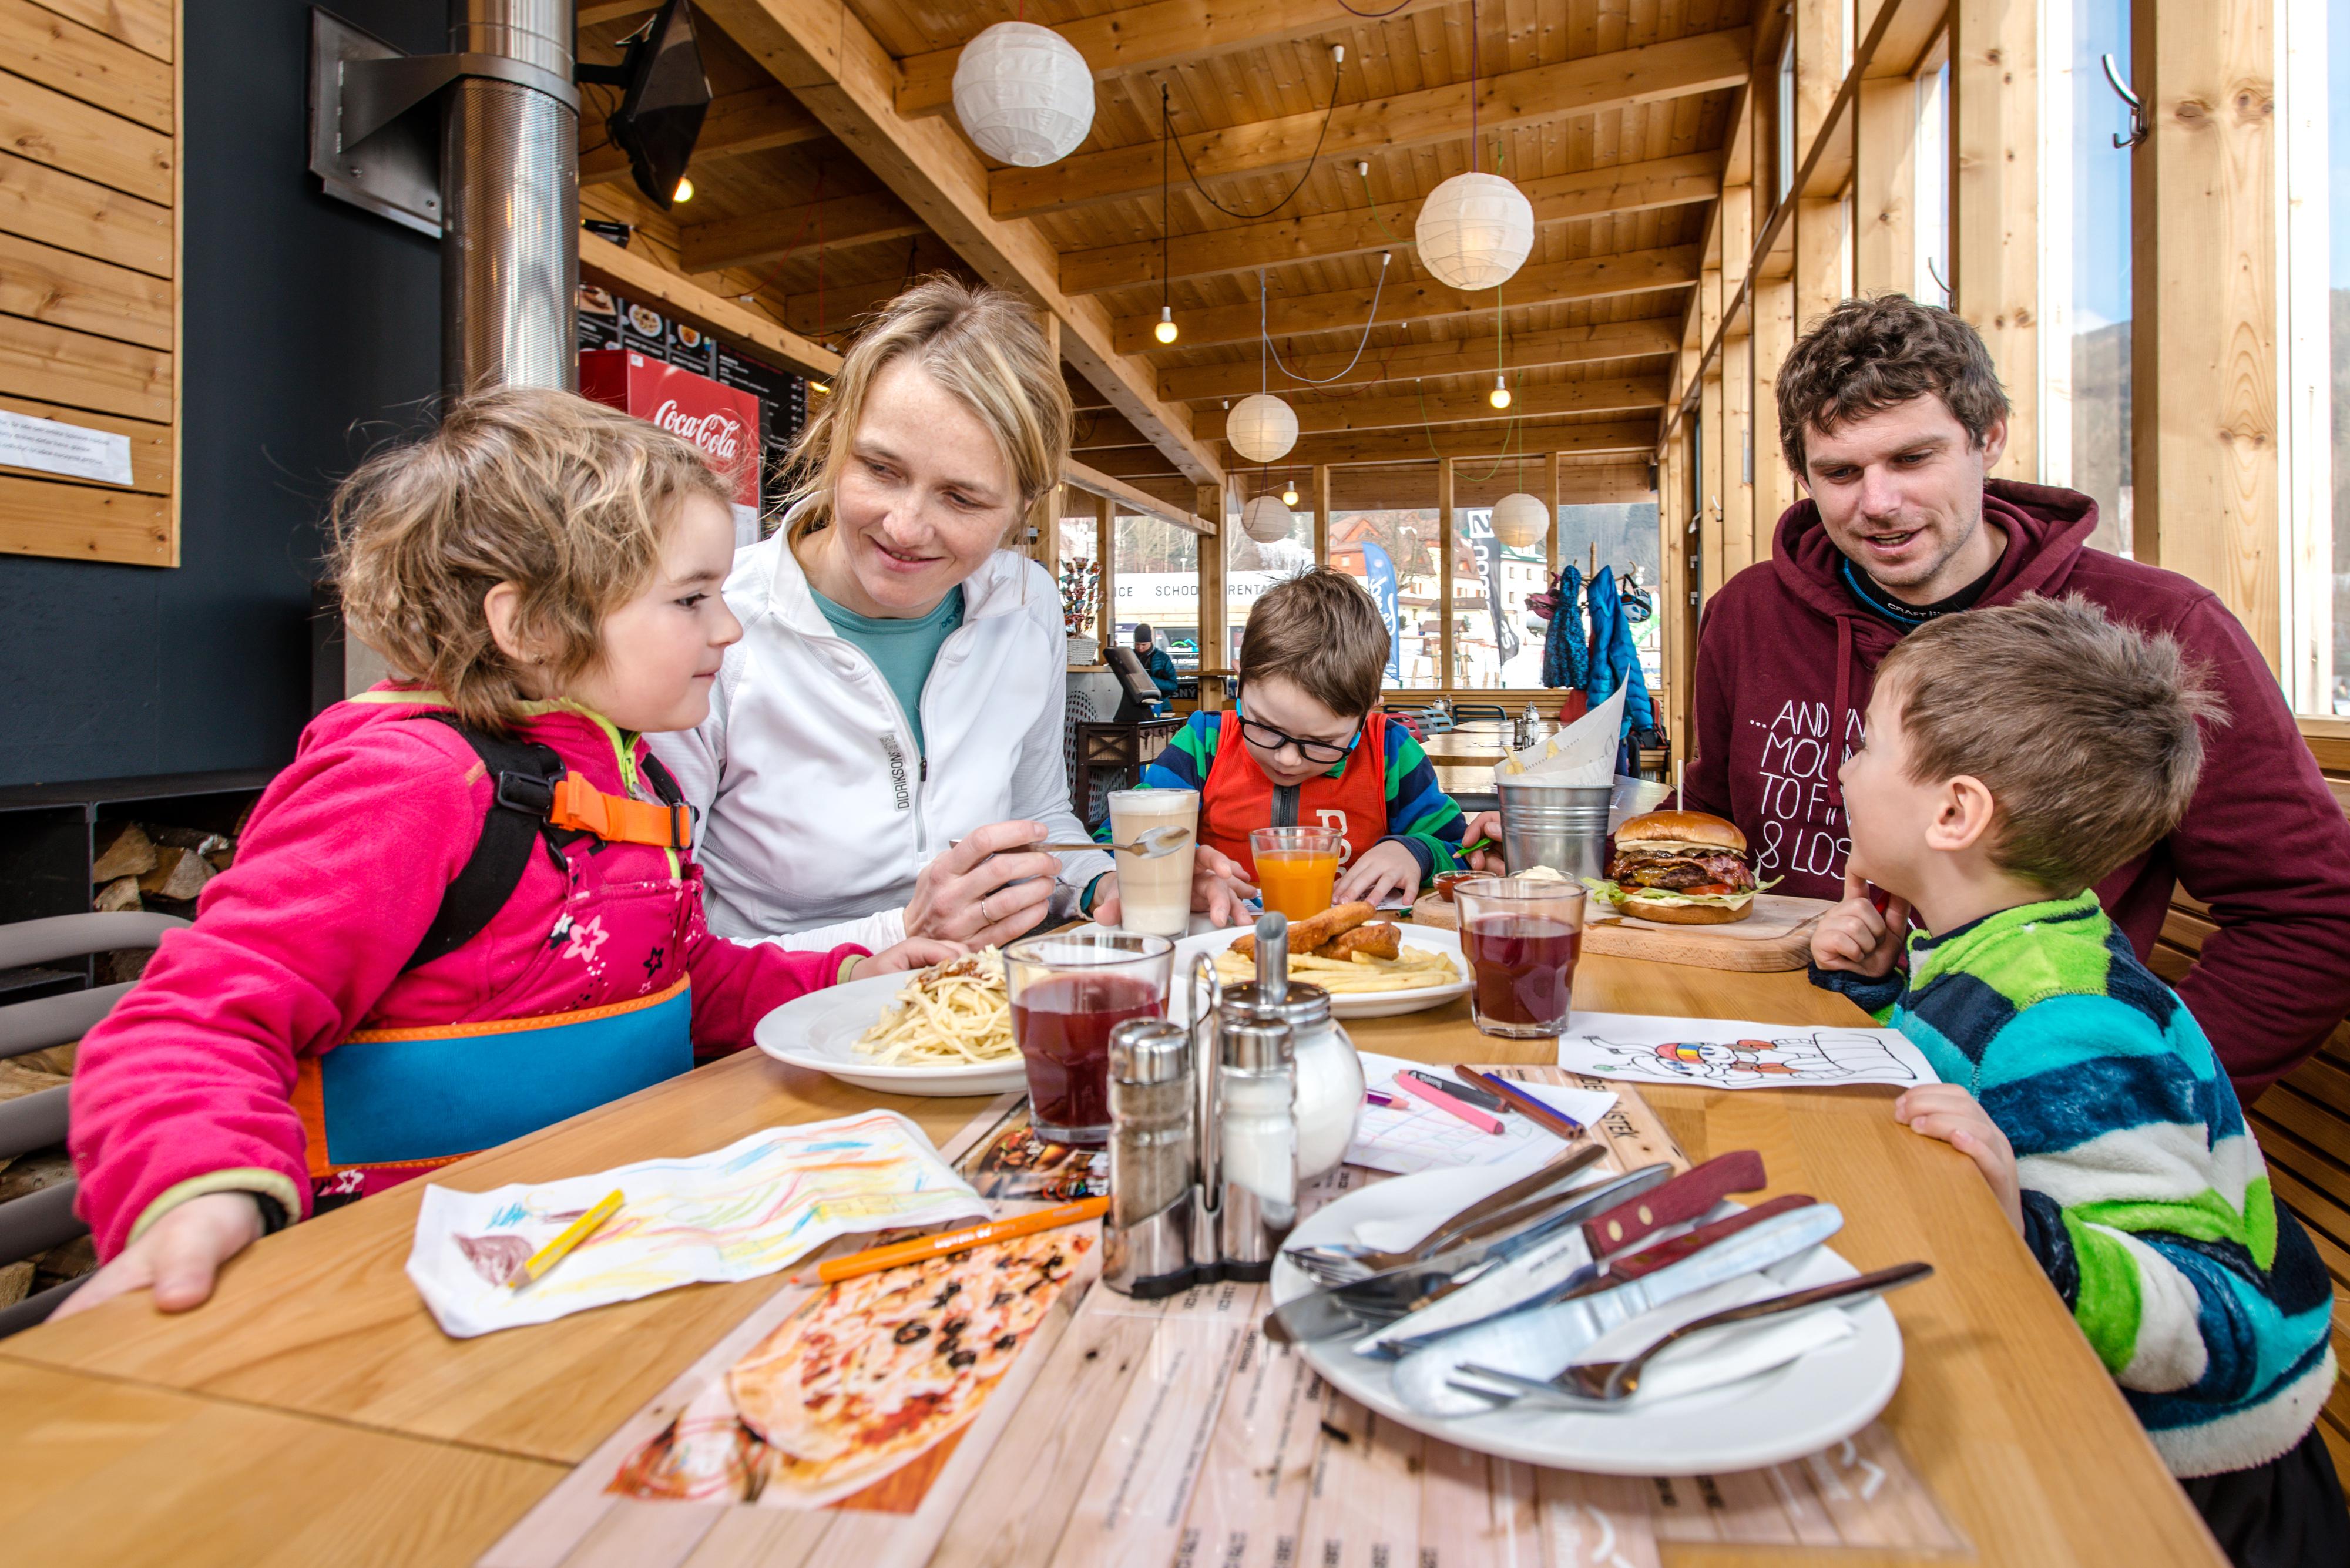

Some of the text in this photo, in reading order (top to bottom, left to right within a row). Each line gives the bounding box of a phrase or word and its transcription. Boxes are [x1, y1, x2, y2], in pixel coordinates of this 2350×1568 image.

[654, 399, 741, 459] Coca-Cola
[1155, 585, 1198, 596] SCHOO
[1888, 603, 1926, 617] CRAFT
[1758, 771, 1800, 820] TO
[1756, 821, 1852, 881] & LOS
